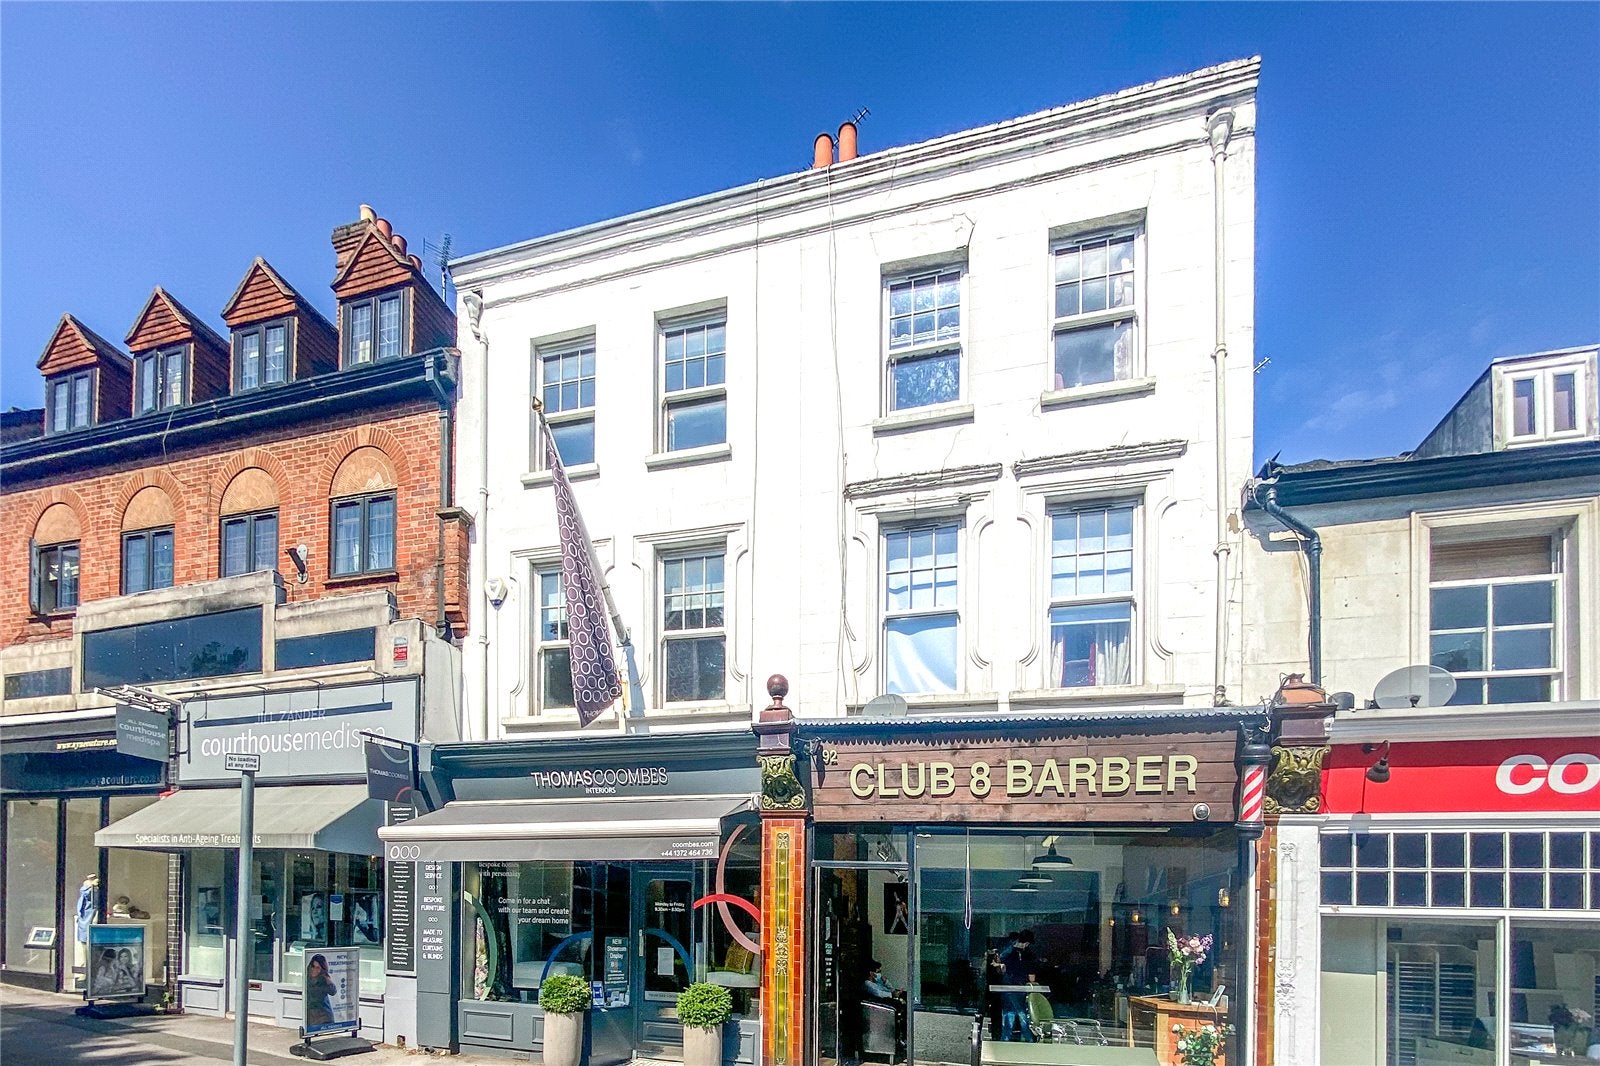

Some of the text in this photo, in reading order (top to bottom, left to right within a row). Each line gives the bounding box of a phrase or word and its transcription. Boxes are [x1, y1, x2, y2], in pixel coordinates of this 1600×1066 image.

[256, 709, 325, 724] JILL ZANDER
[119, 723, 166, 739] courthouse
[126, 733, 161, 746] medispa
[822, 750, 838, 762] 92
[531, 767, 668, 787] THOMASCOOMBES
[850, 755, 1199, 797] CLUB 8 BARBER
[1495, 753, 1600, 795] CO
[585, 786, 616, 794] INTERIORS
[135, 834, 171, 844] Specialists
[172, 834, 178, 843] in
[179, 834, 219, 846] Anti-Ageing
[491, 870, 521, 878] personality
